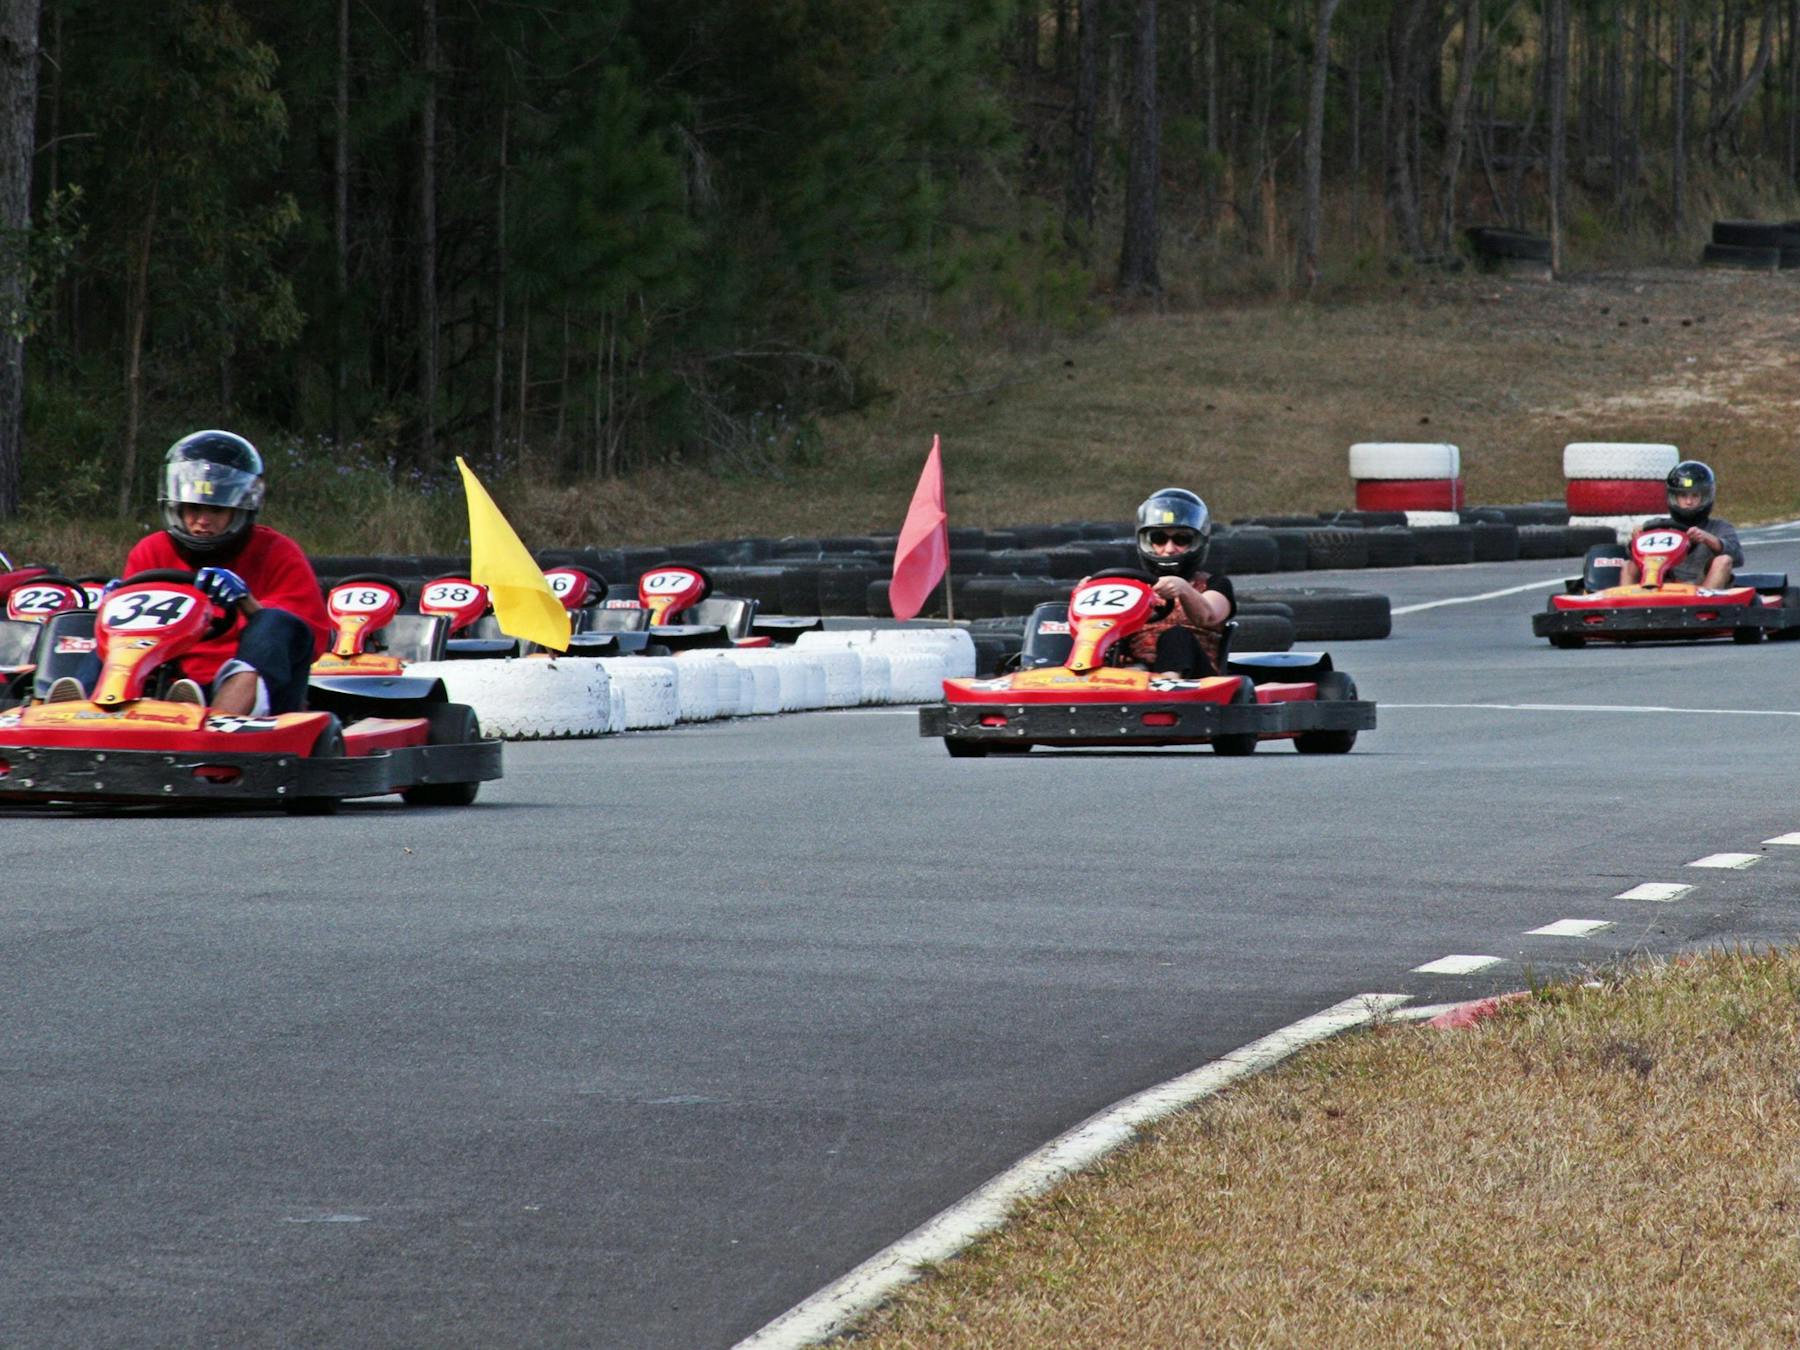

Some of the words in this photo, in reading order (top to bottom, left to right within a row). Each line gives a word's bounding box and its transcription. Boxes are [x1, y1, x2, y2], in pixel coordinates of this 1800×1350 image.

[1640, 536, 1674, 547] 44
[552, 577, 568, 591] 6
[650, 575, 685, 588] 07
[16, 590, 65, 610] 22
[340, 591, 378, 606] 18
[430, 587, 469, 602] 38
[1080, 589, 1128, 607] 42
[108, 594, 189, 627] 34
